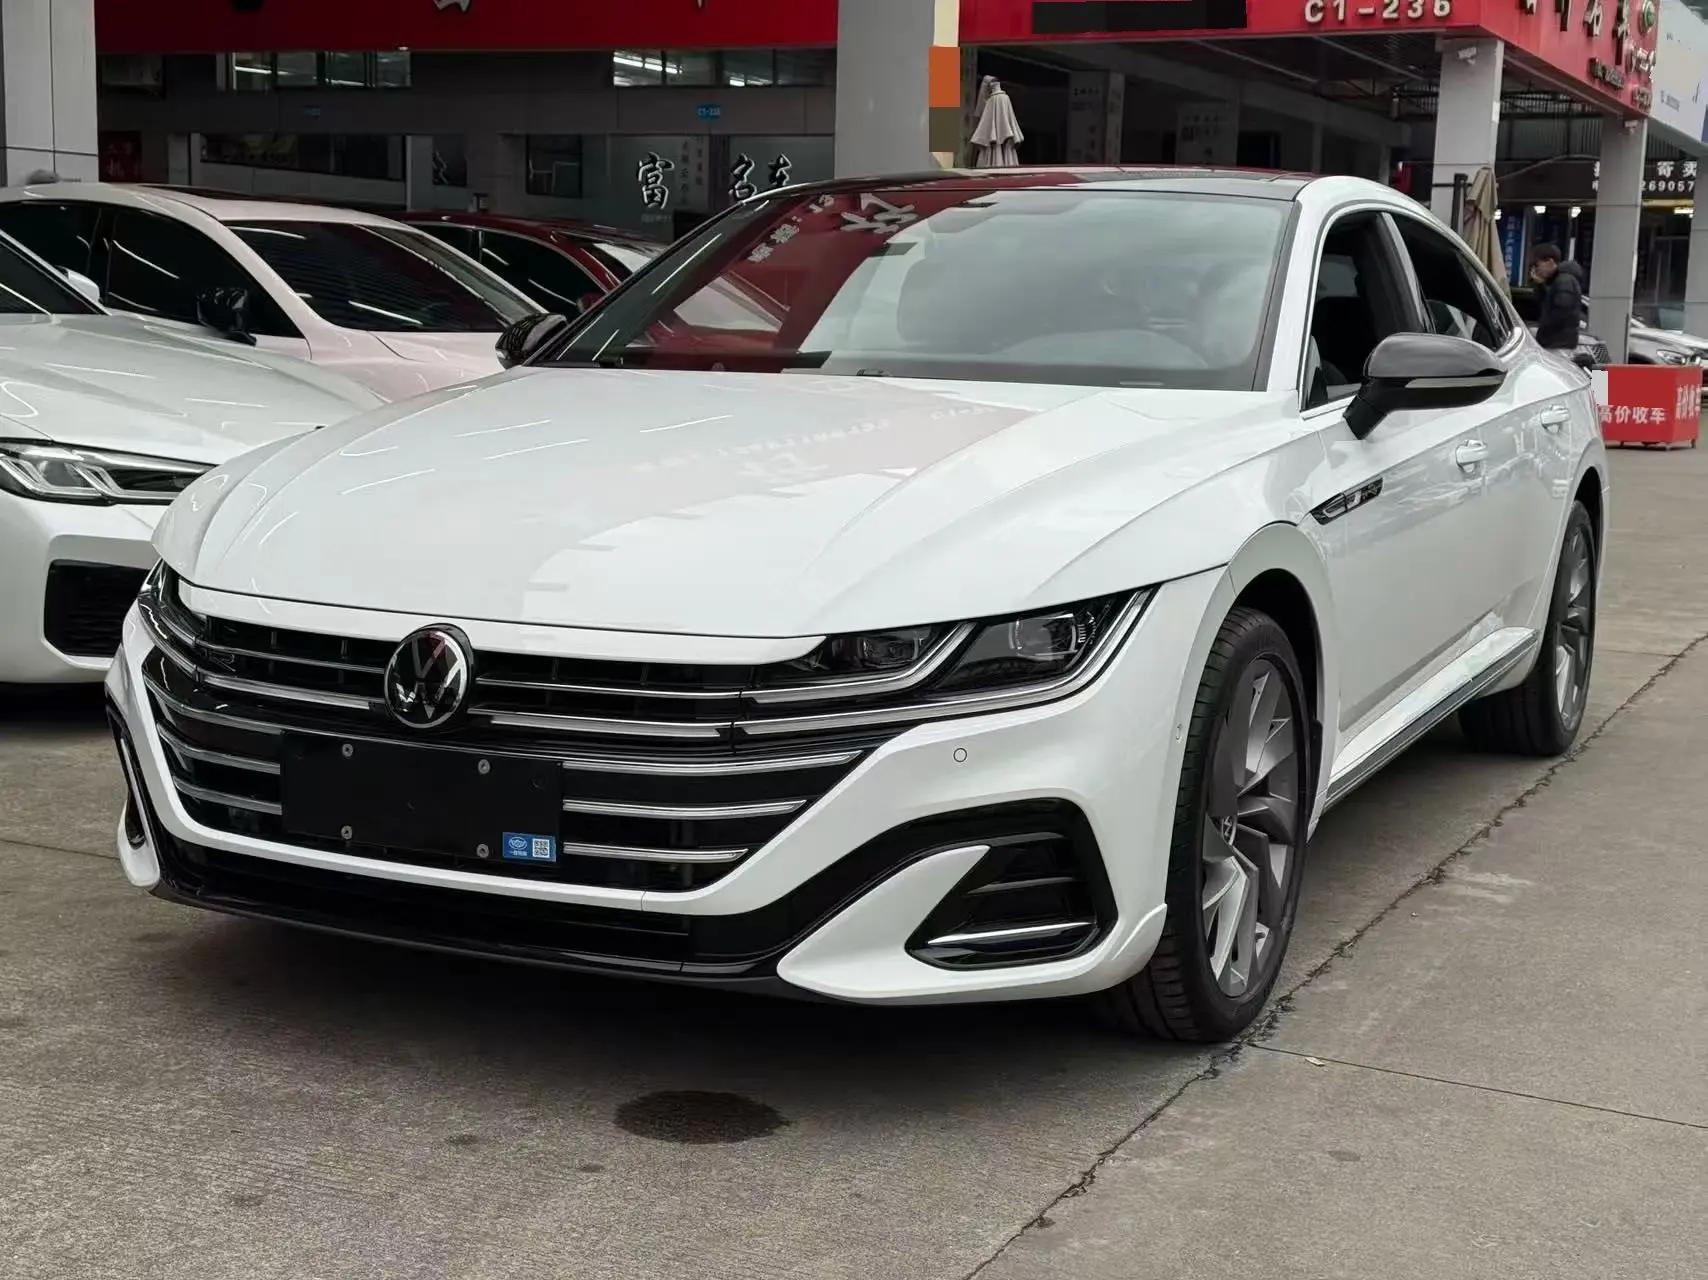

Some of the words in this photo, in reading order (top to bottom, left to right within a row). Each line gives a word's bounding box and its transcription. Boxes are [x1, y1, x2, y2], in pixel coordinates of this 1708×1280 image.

[1305, 0, 1450, 22] C1-236
[1599, 404, 1667, 425] 高价收车
